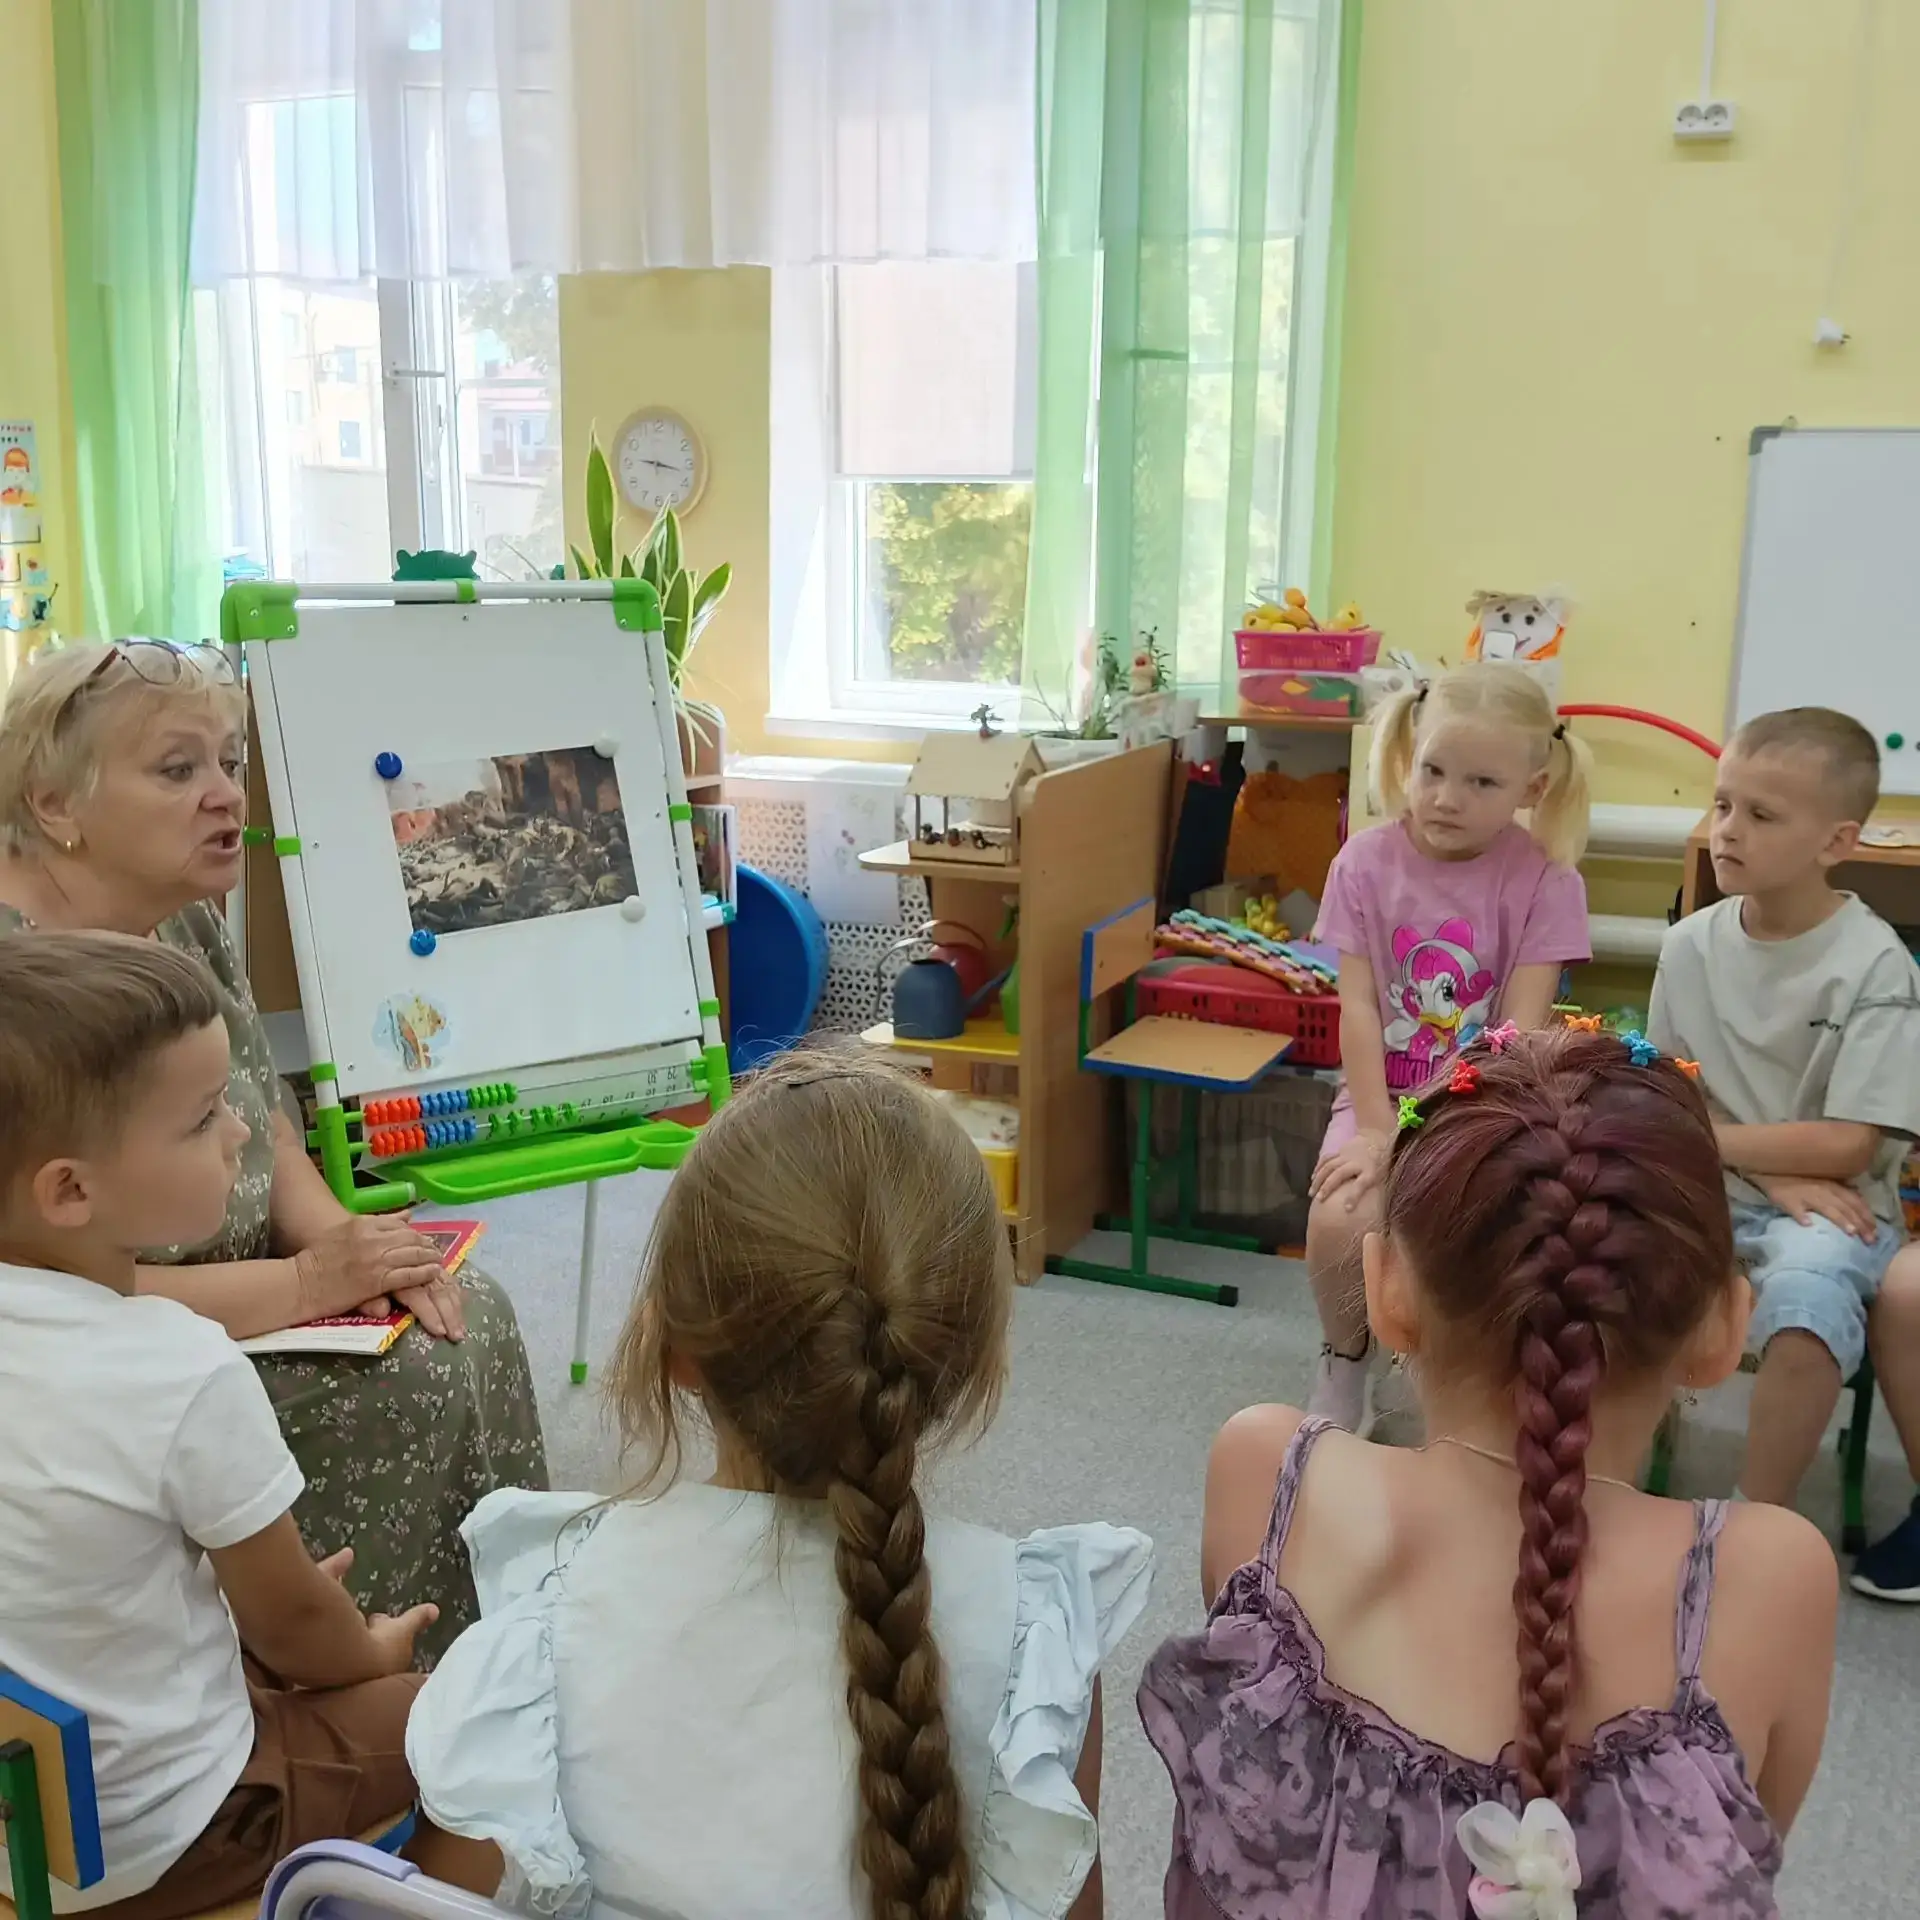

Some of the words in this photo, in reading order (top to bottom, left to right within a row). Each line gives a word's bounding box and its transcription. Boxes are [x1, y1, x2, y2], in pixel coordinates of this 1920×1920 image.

[680, 438, 690, 452] 2
[680, 476, 689, 488] 4
[641, 490, 649, 501] 7
